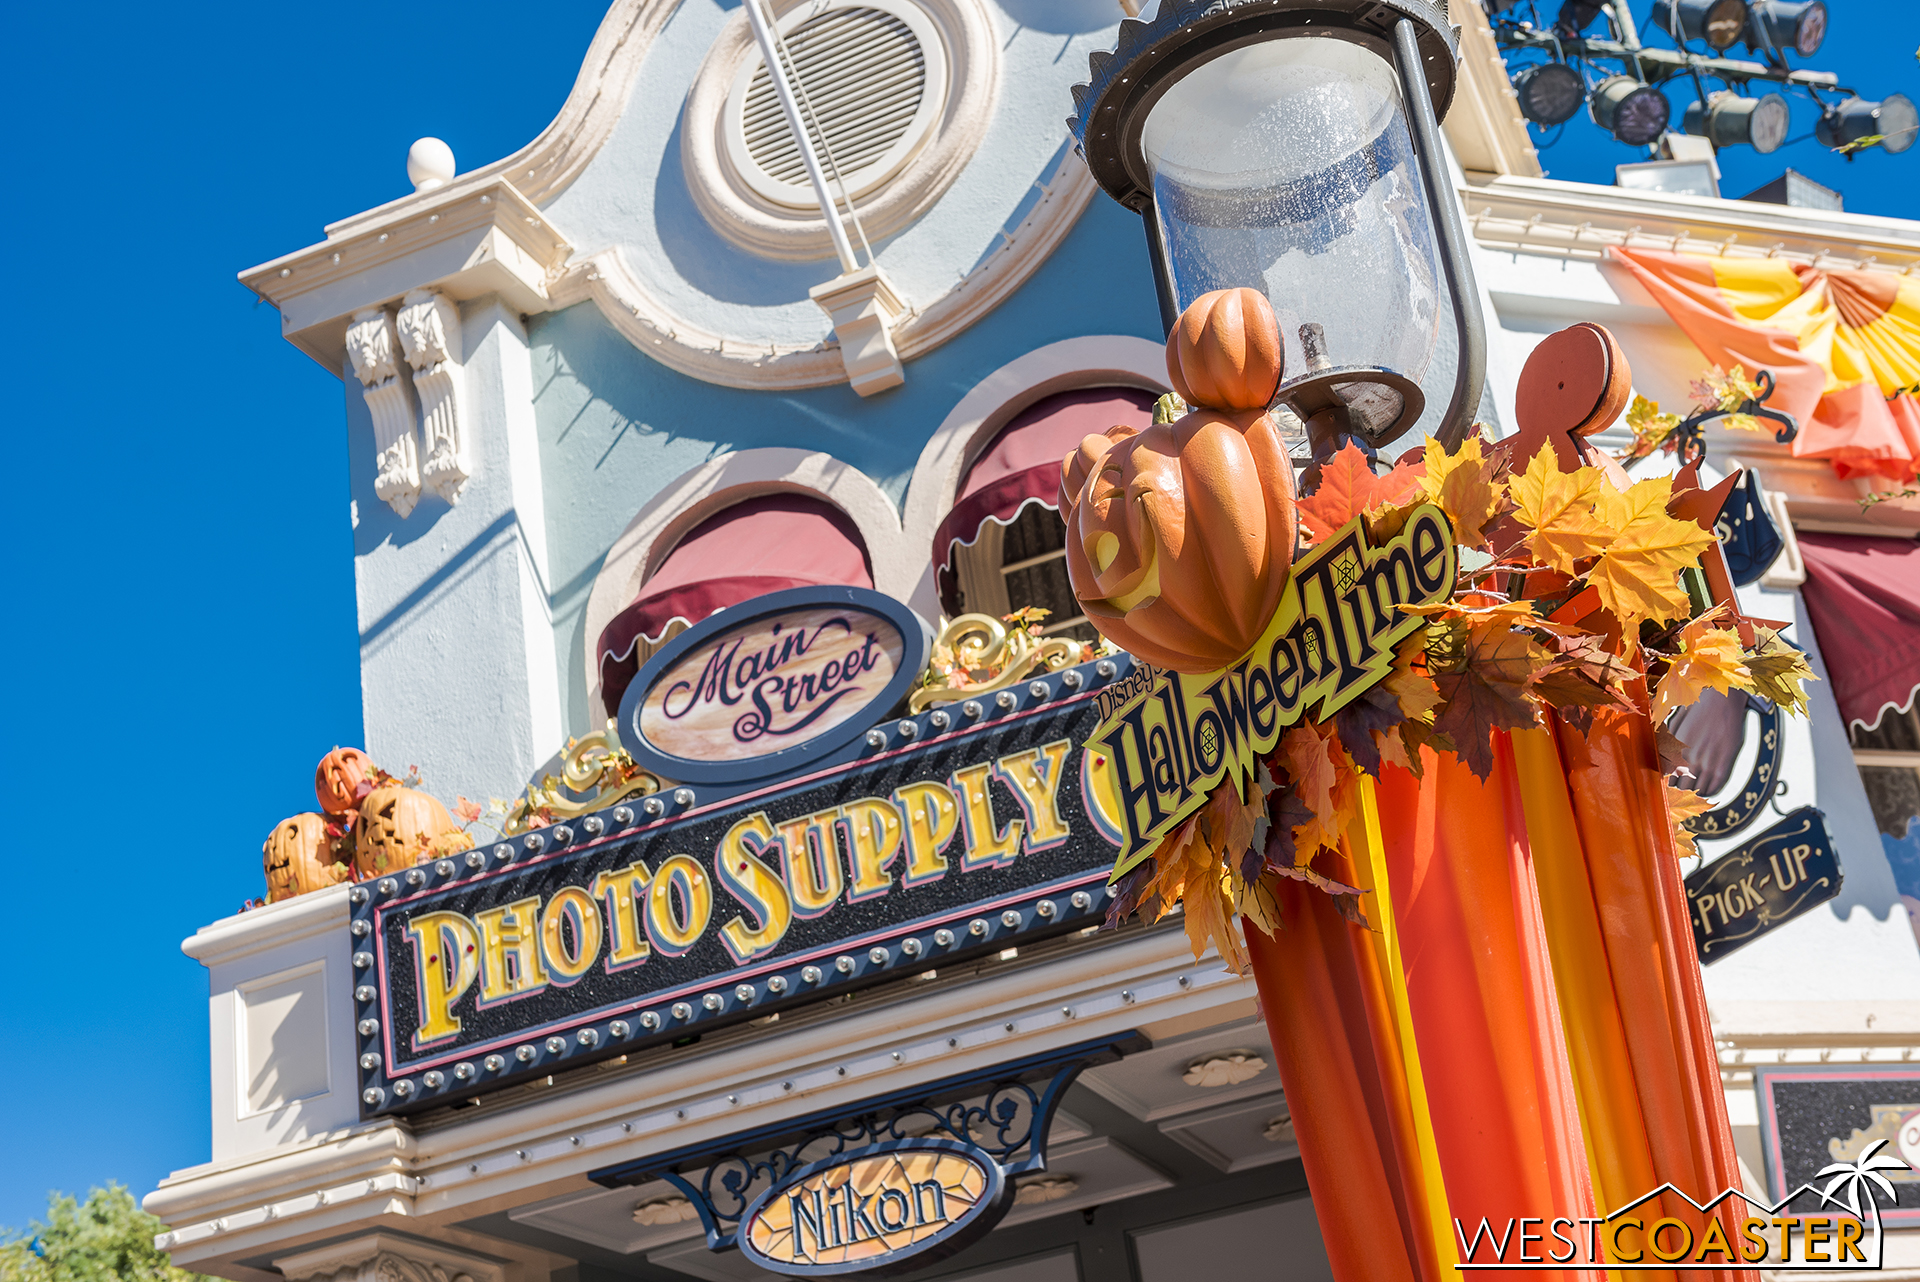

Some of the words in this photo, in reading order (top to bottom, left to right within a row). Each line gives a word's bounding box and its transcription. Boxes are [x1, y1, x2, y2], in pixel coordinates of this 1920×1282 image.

[662, 616, 853, 720] Main
[733, 631, 882, 743] Street
[1095, 662, 1163, 726] Disney
[402, 852, 714, 1053] PHOTO
[714, 737, 1073, 966] SUPPLY
[1696, 843, 1812, 936] PICK-UP
[788, 1178, 947, 1257] Nikon
